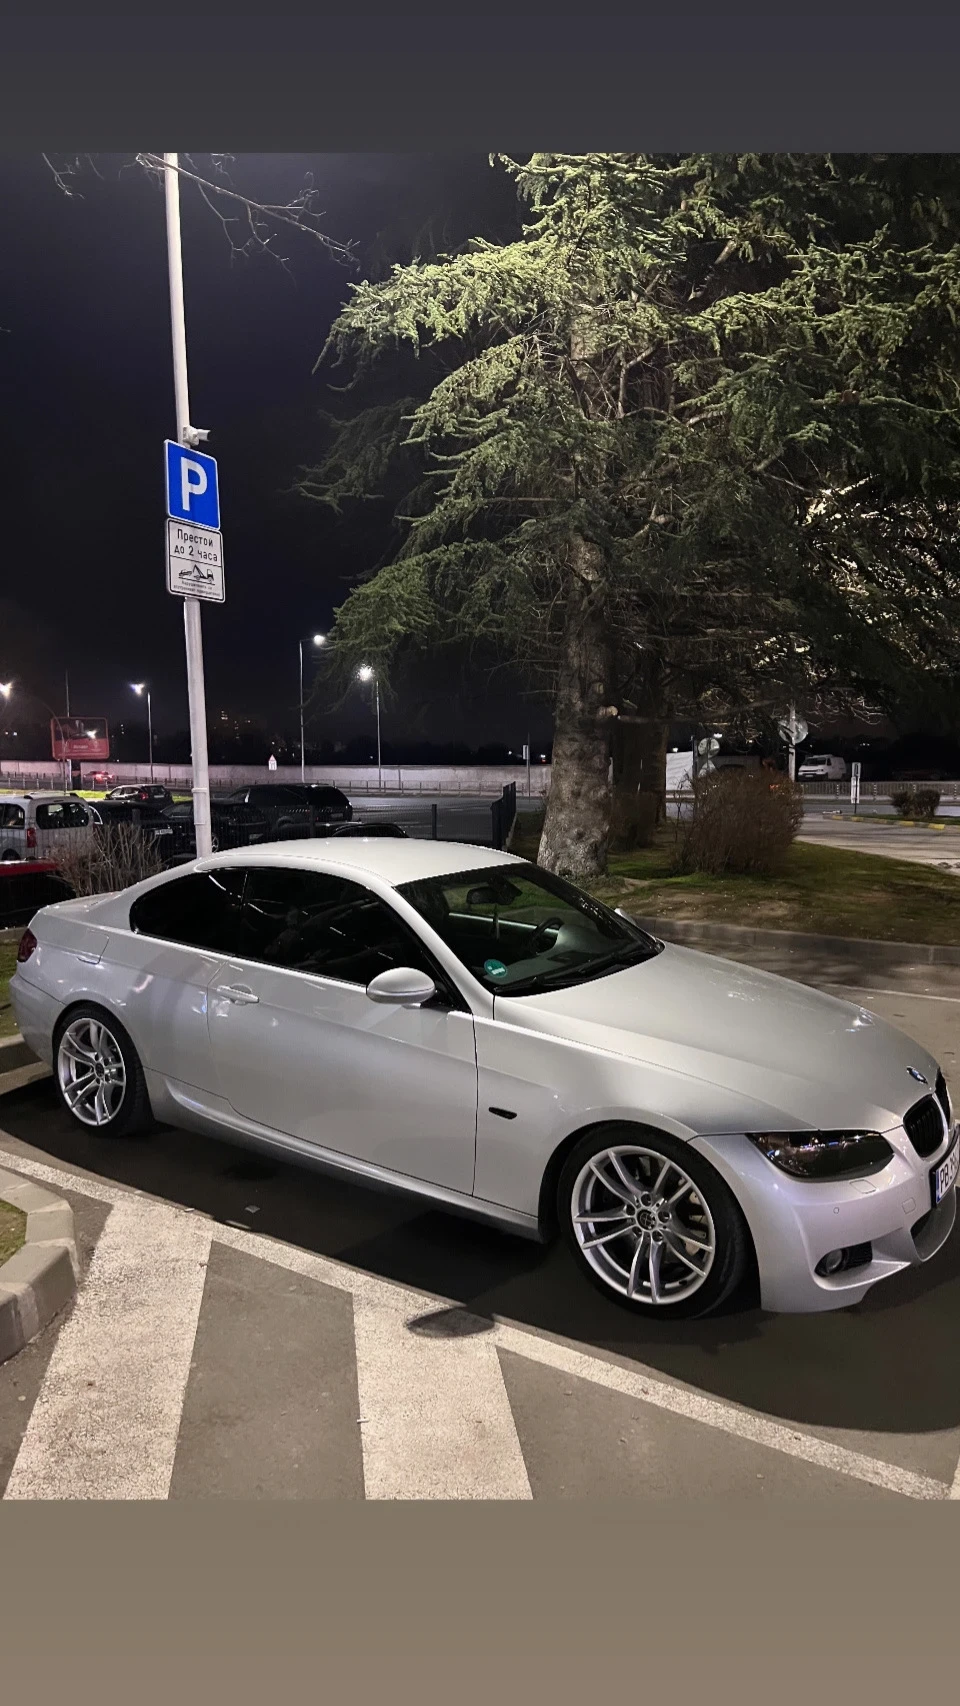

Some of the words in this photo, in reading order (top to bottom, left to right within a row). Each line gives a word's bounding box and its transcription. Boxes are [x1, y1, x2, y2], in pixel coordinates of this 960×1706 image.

[181, 456, 208, 512] P
[177, 528, 214, 547] Престой
[188, 545, 195, 557] 2
[197, 550, 218, 562] часа
